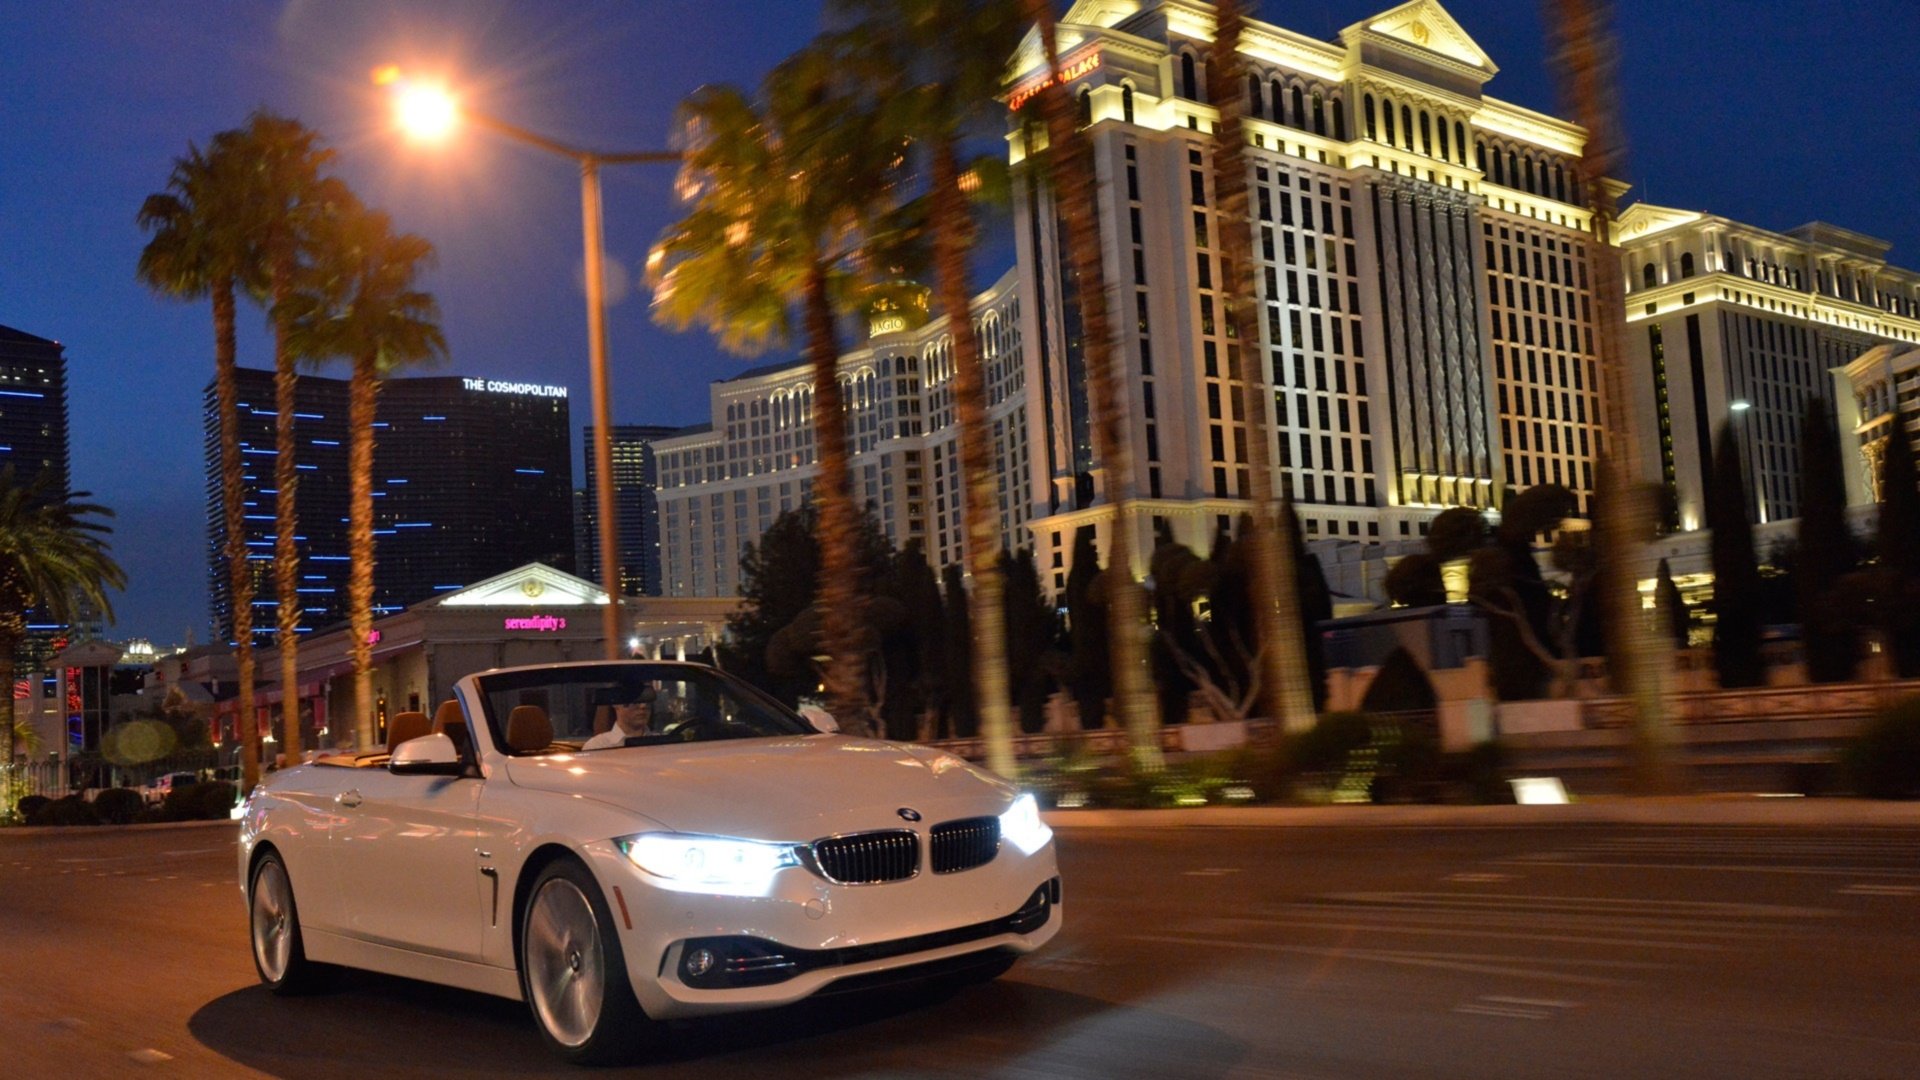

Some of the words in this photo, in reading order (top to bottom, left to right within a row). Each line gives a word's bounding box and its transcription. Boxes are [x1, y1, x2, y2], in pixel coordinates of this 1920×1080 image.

[462, 378, 485, 391] THE
[487, 380, 567, 398] COSMOPOLITAN
[559, 617, 566, 629] 3
